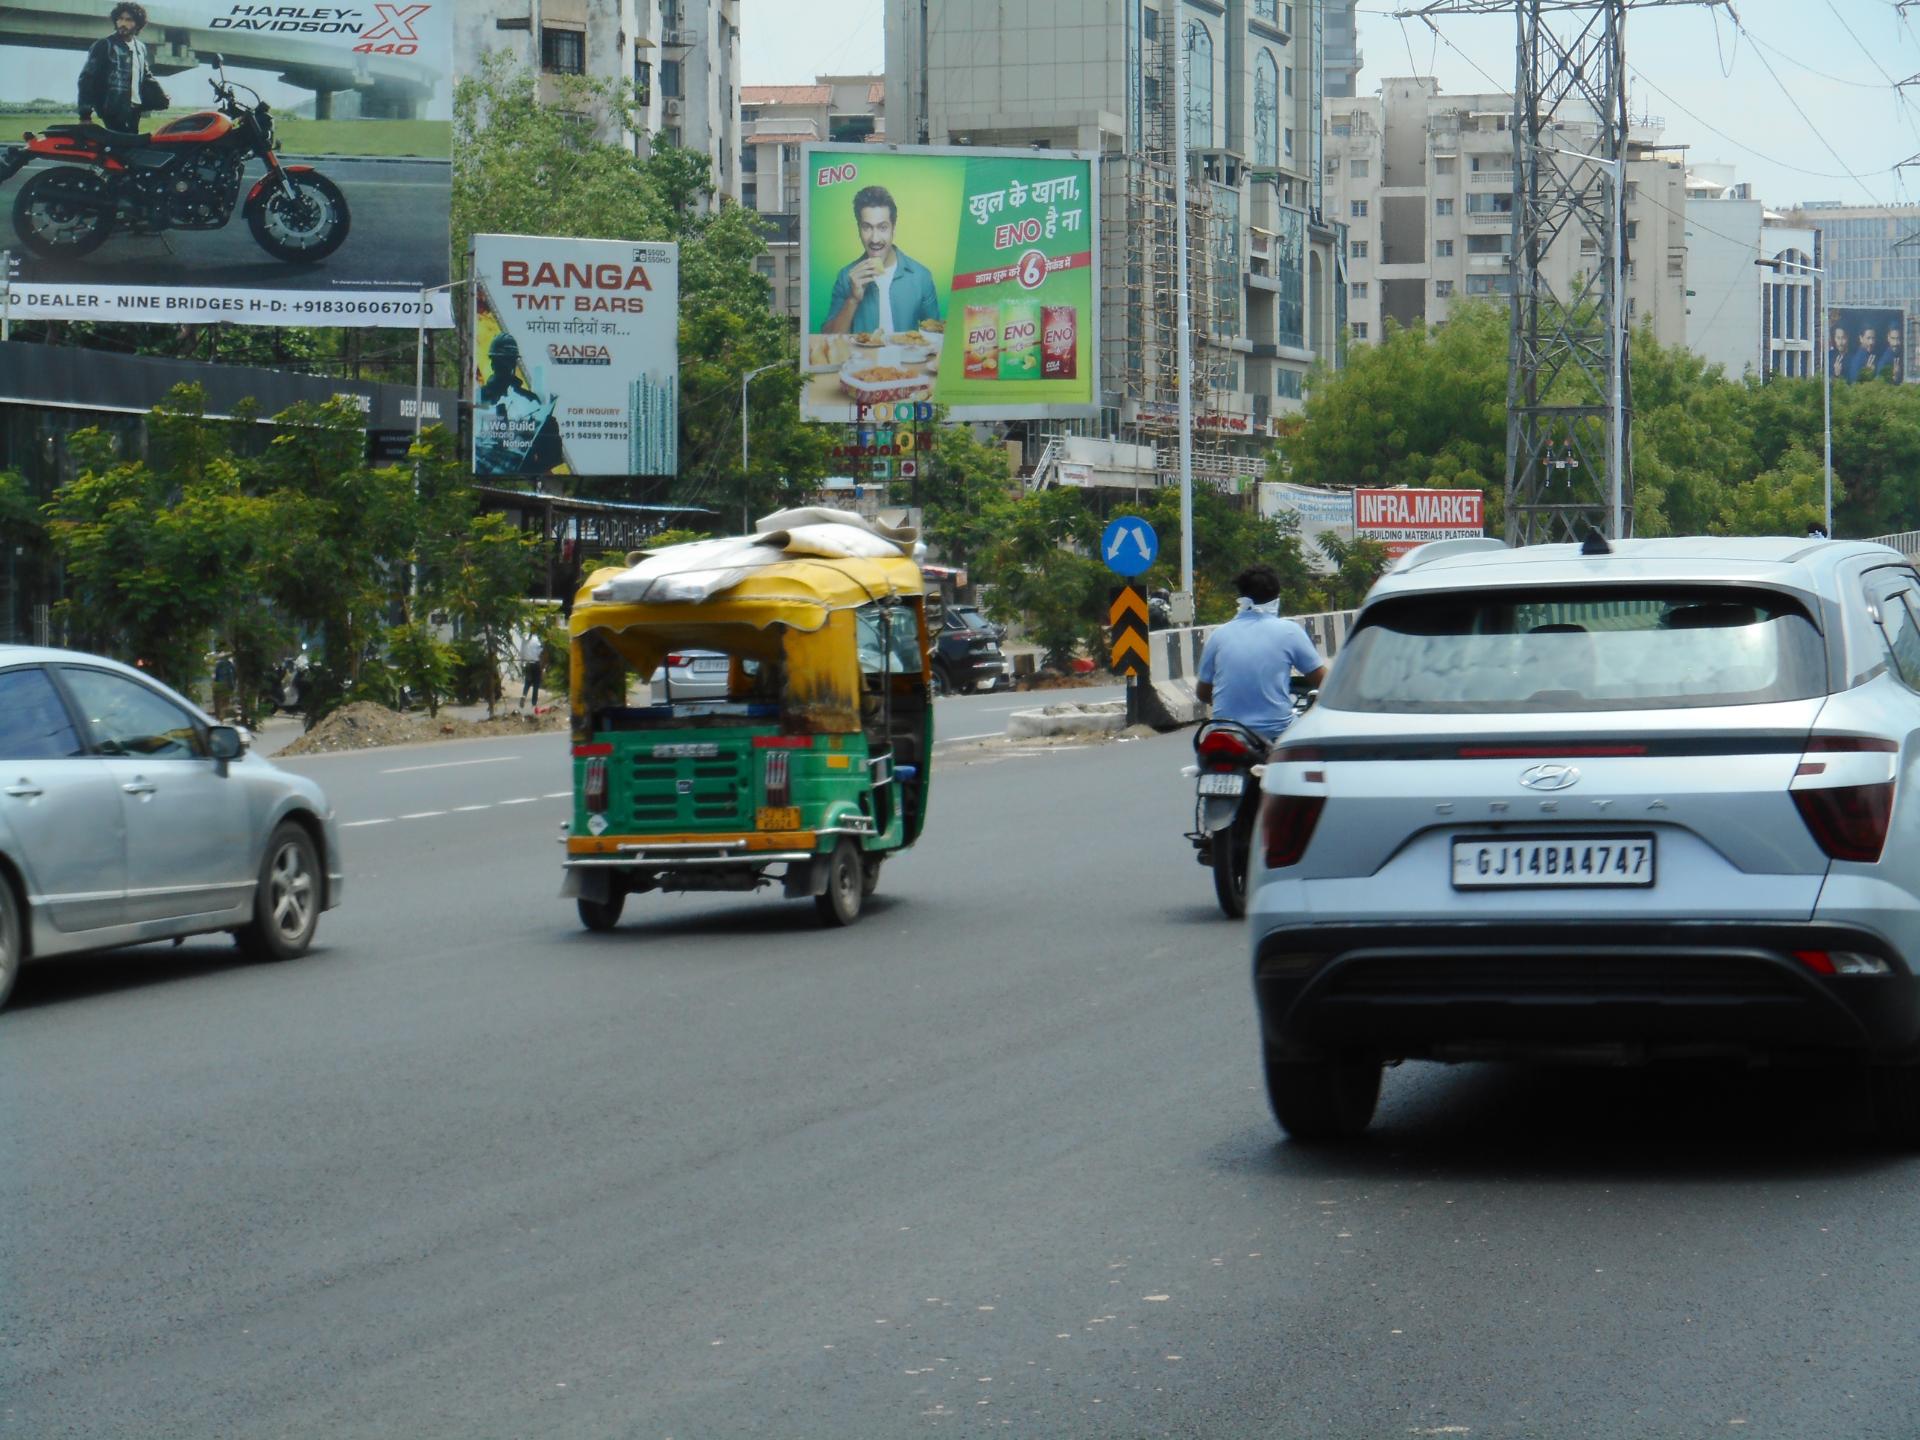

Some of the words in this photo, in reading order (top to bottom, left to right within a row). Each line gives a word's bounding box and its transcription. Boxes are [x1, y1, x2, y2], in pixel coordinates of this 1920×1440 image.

[230, 4, 363, 19] HARLEY-
[358, 3, 432, 41] X
[208, 17, 364, 34] DAVIDSON
[351, 42, 418, 56] 440
[817, 163, 857, 187] ENO
[968, 190, 1006, 225] खुल
[1008, 179, 1029, 208] के
[1031, 175, 1080, 204] खाना,
[994, 217, 1043, 250] ENO
[1044, 205, 1059, 239] है
[1061, 208, 1082, 232] ना
[501, 260, 654, 292] BANGA
[1023, 256, 1041, 286] 6
[27, 293, 99, 307] DEALER
[117, 296, 161, 309] NINE
[166, 297, 244, 311] BRIDGES
[249, 299, 288, 312] H-D:
[292, 300, 434, 315] +918306067070
[512, 294, 566, 311] TMT
[574, 296, 644, 314] BARS
[526, 316, 561, 334] भरोसा
[562, 316, 599, 336] सदियों
[968, 327, 997, 345] ENO
[1003, 322, 1036, 342] ENO
[1044, 326, 1073, 345] ENO
[567, 407, 584, 415] FOR
[586, 407, 621, 416] INQUIRY
[857, 400, 933, 423] FOOD
[489, 420, 507, 431] We
[508, 420, 535, 432] Build
[1360, 493, 1481, 525] INFRA.MARKET
[1405, 530, 1443, 540] MATERIALS
[1444, 530, 1481, 540] PLATFORM
[1434, 798, 1668, 816] CRETA
[1476, 845, 1648, 876] GJ14BA4747
